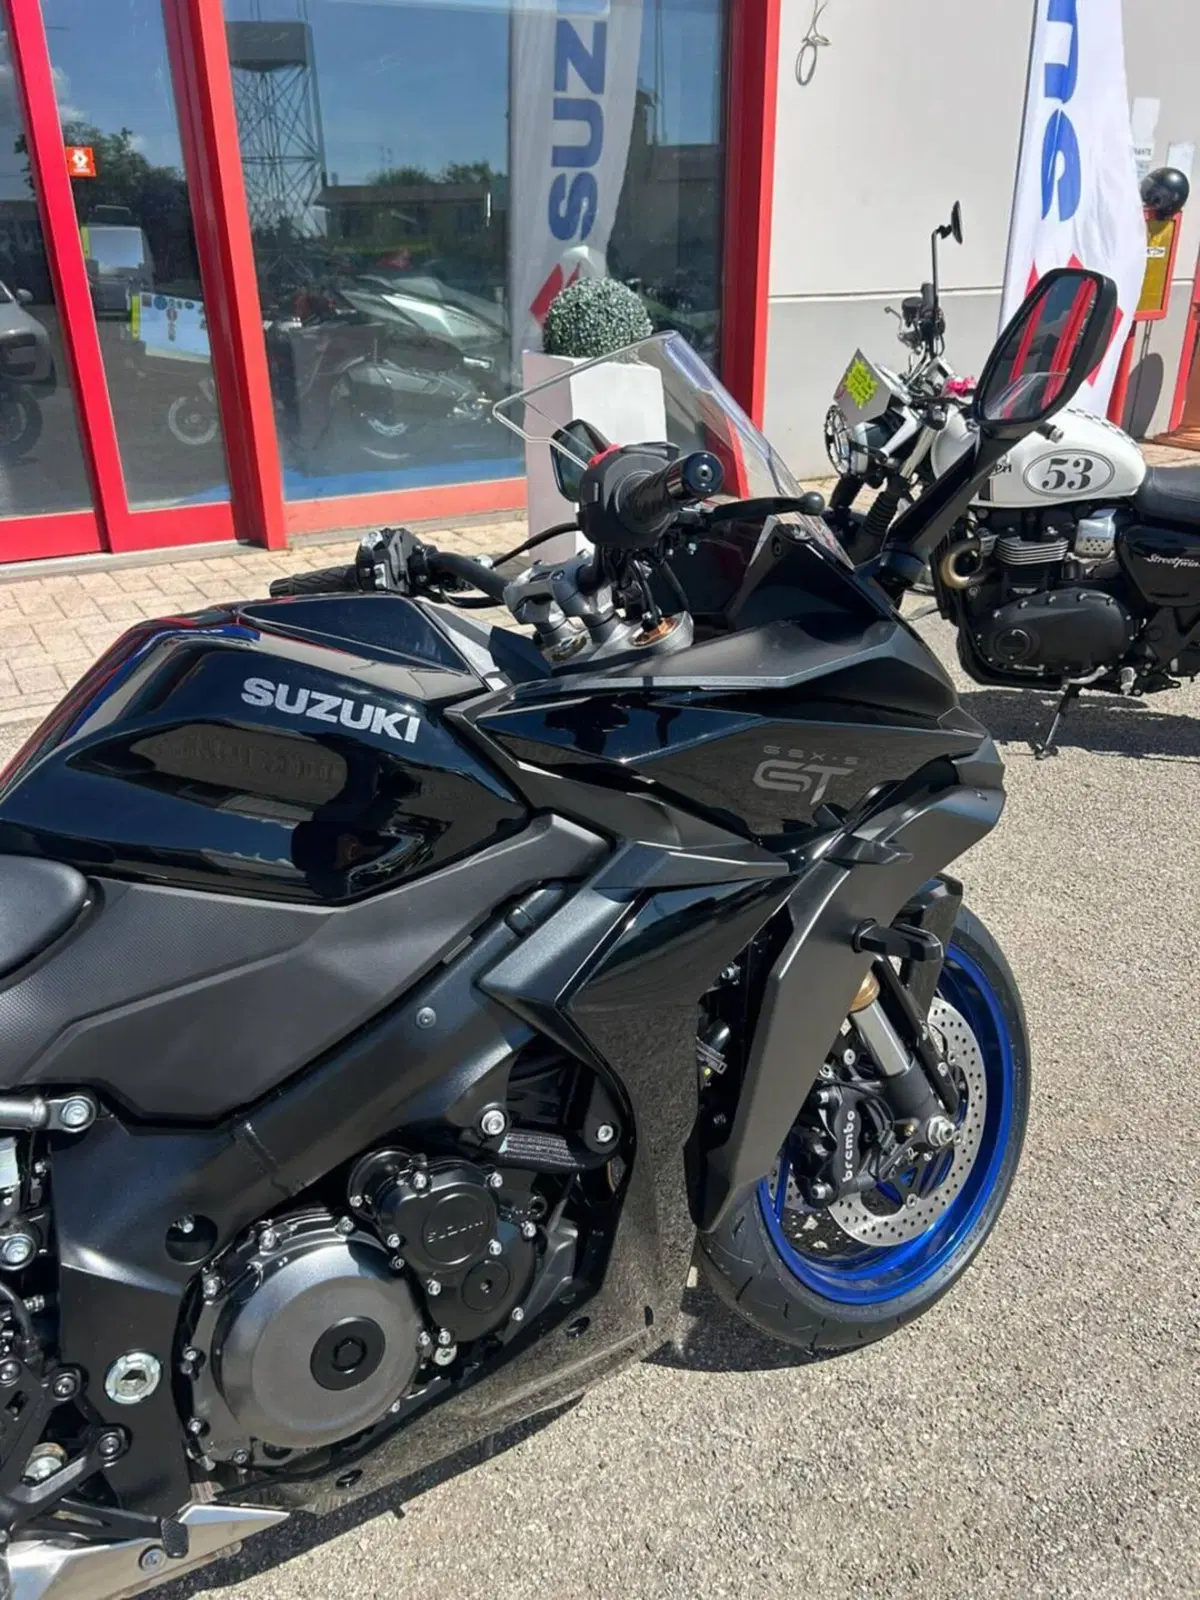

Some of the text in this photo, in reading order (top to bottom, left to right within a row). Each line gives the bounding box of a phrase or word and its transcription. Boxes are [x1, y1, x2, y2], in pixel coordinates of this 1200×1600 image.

[548, 0, 608, 241] SUZ
[1041, 457, 1094, 490] 53
[241, 677, 421, 743] SUZUKI
[752, 759, 855, 806] GT
[842, 1110, 855, 1182] brembo
